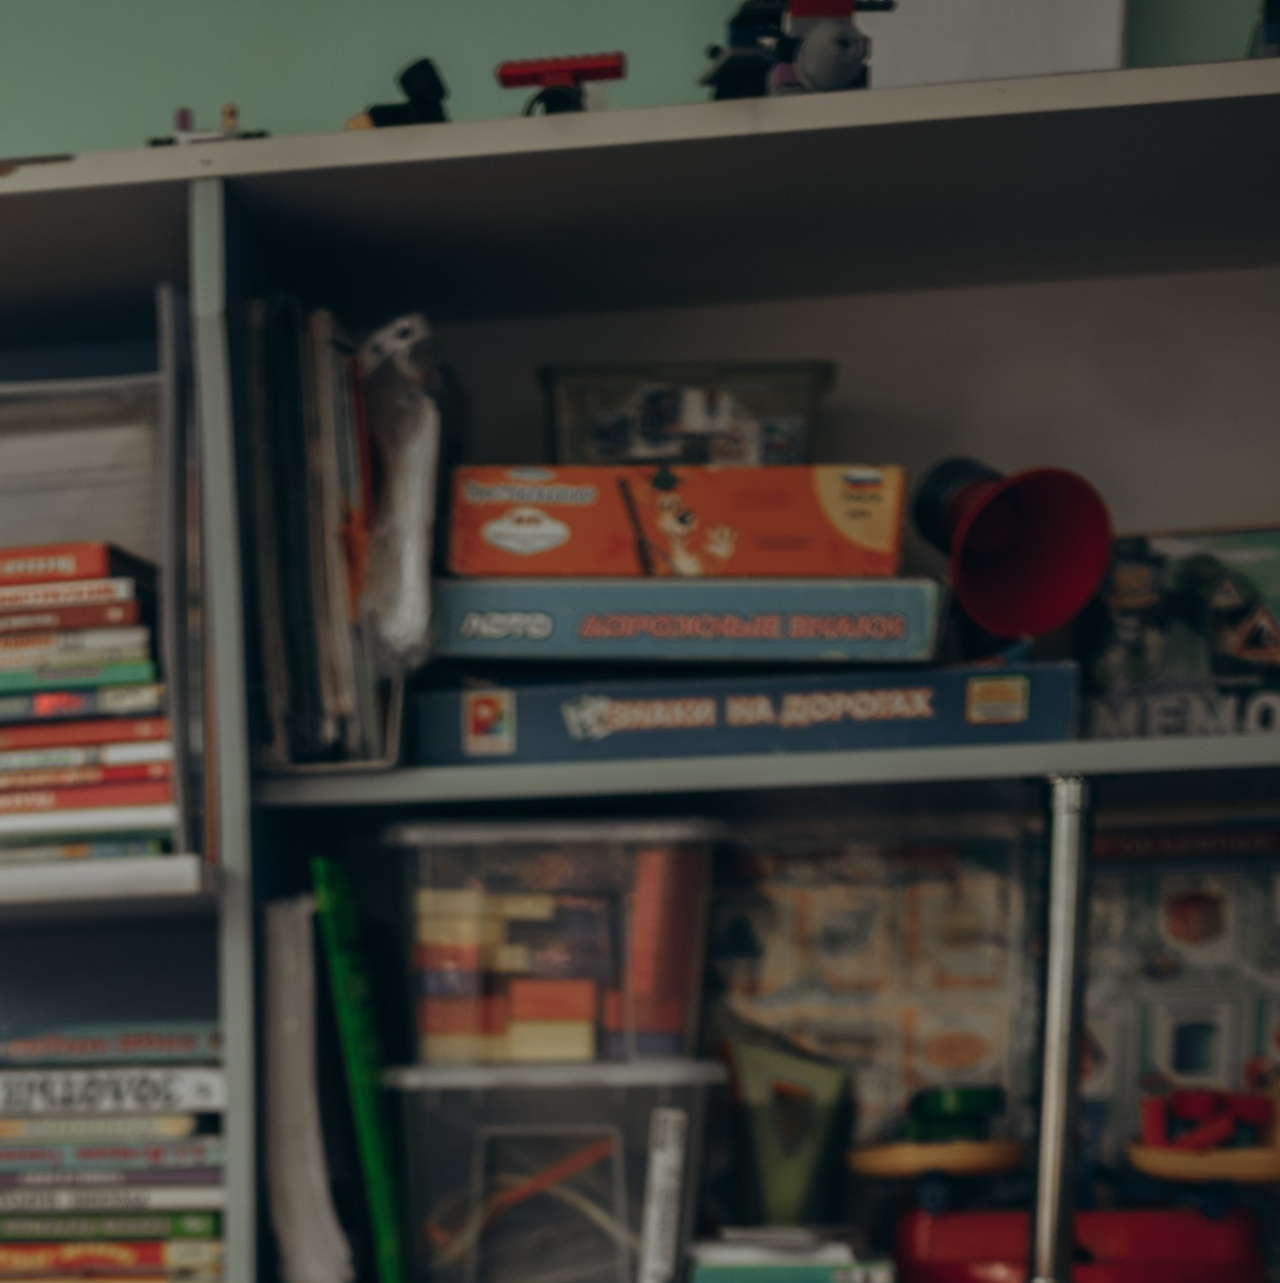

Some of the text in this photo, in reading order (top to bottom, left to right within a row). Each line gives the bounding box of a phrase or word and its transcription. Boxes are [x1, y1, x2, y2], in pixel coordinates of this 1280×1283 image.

[460, 612, 554, 640] ЛОТО
[577, 612, 780, 640] ДОРОЖНЫЕ
[725, 694, 776, 727] НА
[779, 687, 935, 729] ДОРОГАХ
